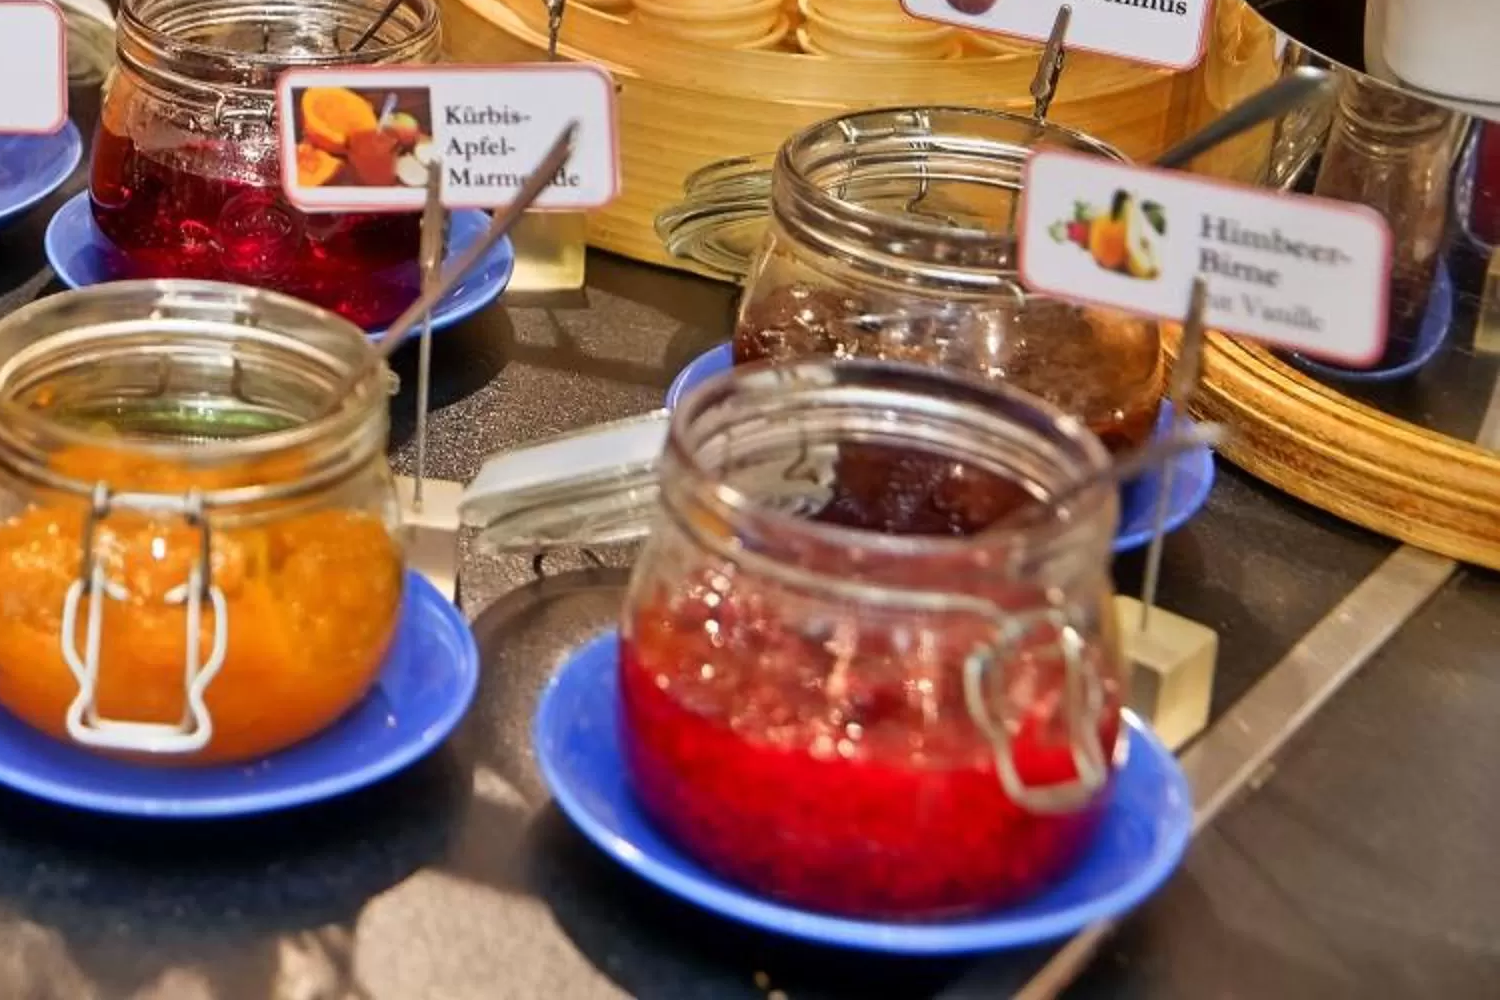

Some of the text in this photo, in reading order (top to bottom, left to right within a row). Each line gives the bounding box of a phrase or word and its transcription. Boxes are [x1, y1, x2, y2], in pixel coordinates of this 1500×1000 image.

[444, 104, 532, 126] Kürbis-
[445, 135, 516, 163] Apfel-
[448, 167, 580, 187] Marmde
[1198, 213, 1353, 265] Himbeer-
[1198, 247, 1282, 288] Birne
